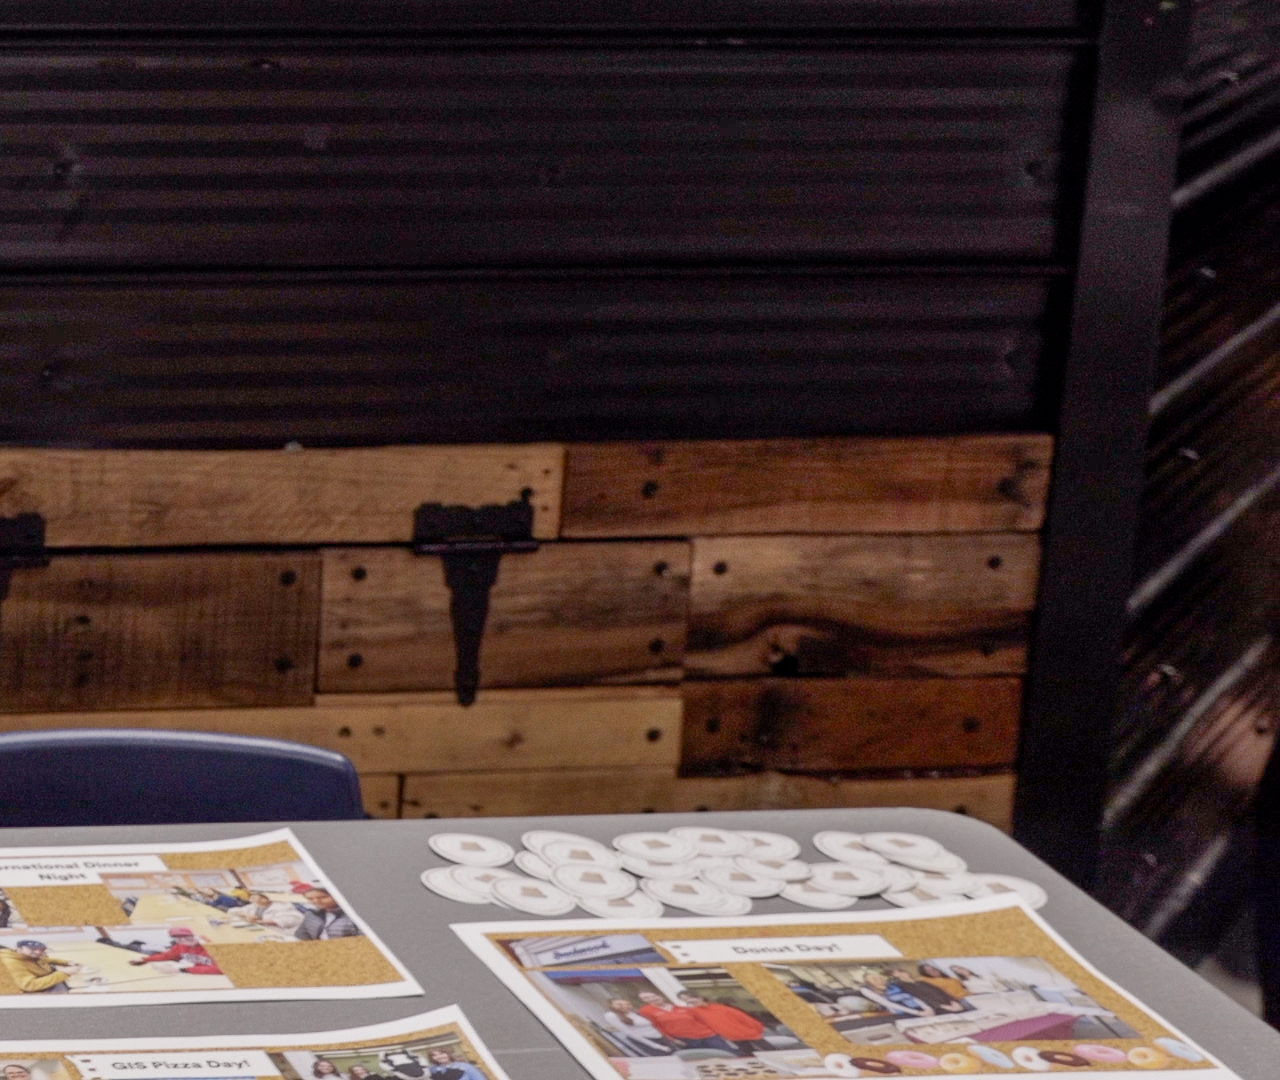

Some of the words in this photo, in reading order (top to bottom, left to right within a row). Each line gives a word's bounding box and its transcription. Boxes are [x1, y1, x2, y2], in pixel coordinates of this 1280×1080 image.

[83, 860, 140, 869] Dinner
[37, 872, 88, 882] Night
[731, 943, 794, 955] Donut
[797, 942, 842, 953] Day!
[111, 1061, 147, 1071] GIS
[151, 1059, 202, 1070] Pizza
[206, 1058, 251, 1070] Day!
